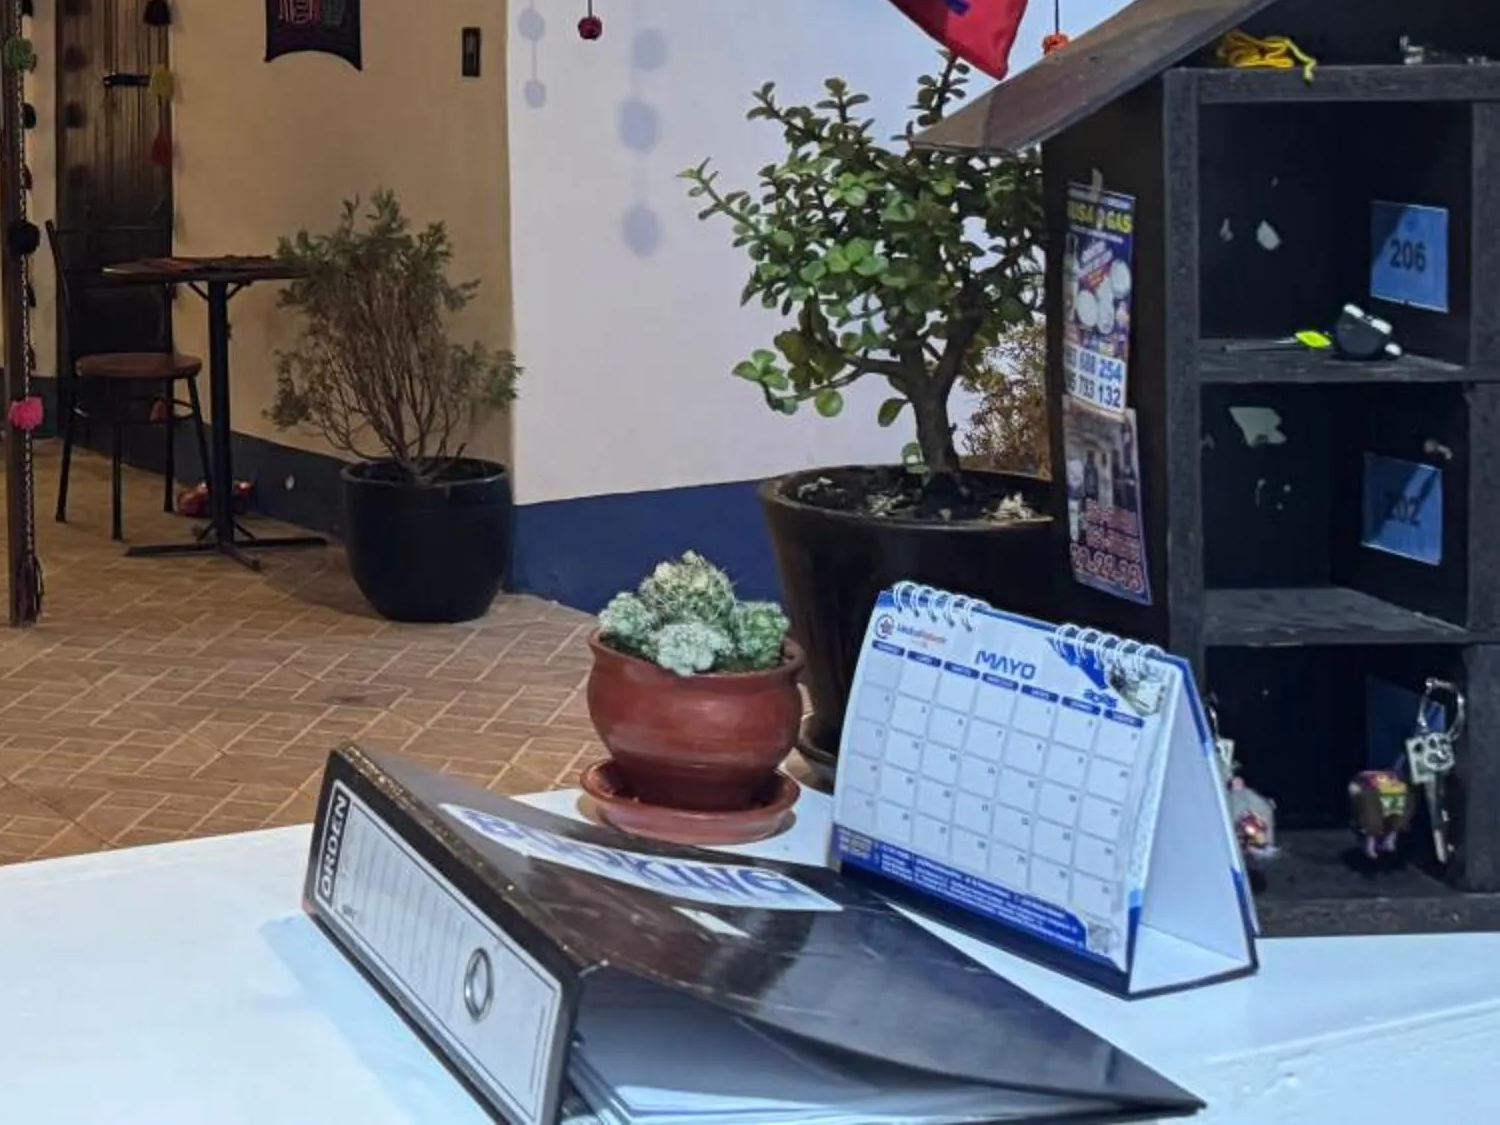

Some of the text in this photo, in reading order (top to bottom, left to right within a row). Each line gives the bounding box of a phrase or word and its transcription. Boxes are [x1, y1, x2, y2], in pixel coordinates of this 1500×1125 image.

[1389, 239, 1427, 272] 206
[1099, 383, 1121, 407] 132
[975, 649, 1037, 680] MAYO
